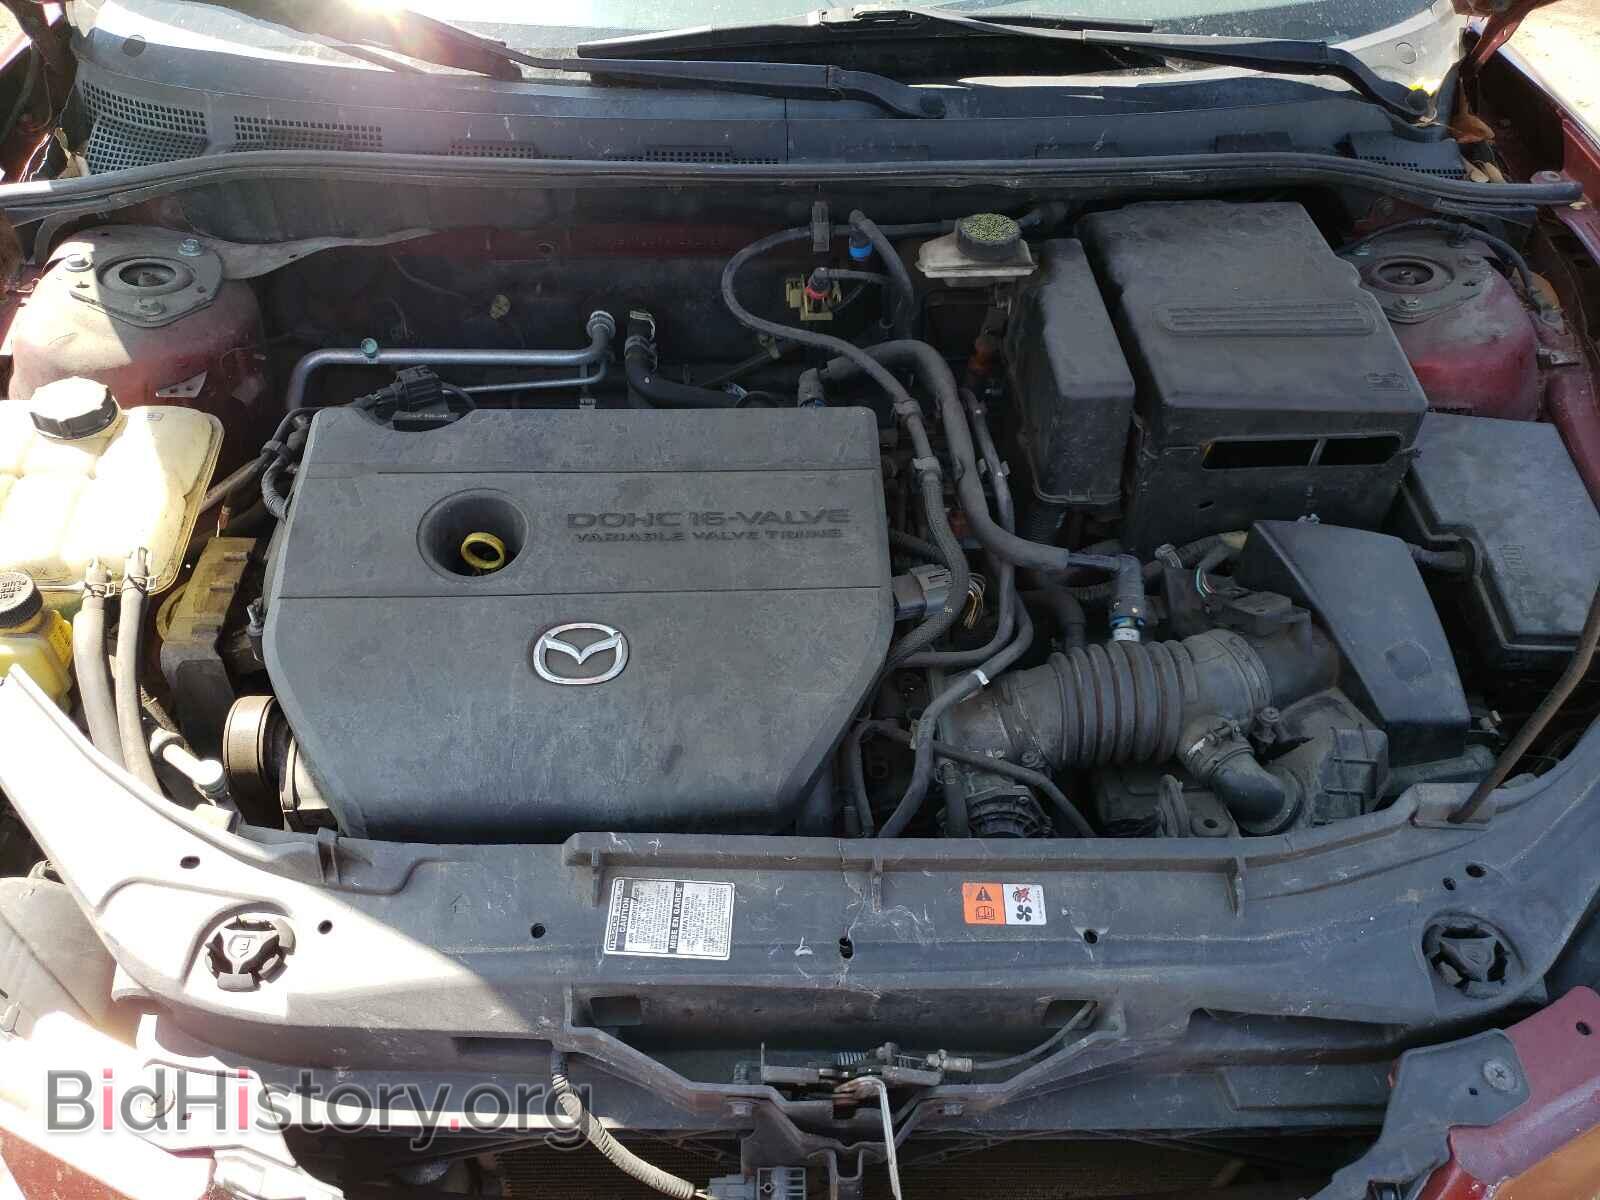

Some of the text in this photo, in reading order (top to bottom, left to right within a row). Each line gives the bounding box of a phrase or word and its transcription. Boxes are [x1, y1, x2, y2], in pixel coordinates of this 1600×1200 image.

[568, 508, 851, 528] DOHC 16-VALVE
[573, 532, 686, 542] VARIABLE
[691, 531, 761, 540] VALVE
[608, 915, 619, 949] mazda
[619, 897, 631, 933] CAUTION
[669, 886, 683, 949] MISE EN GARDE
